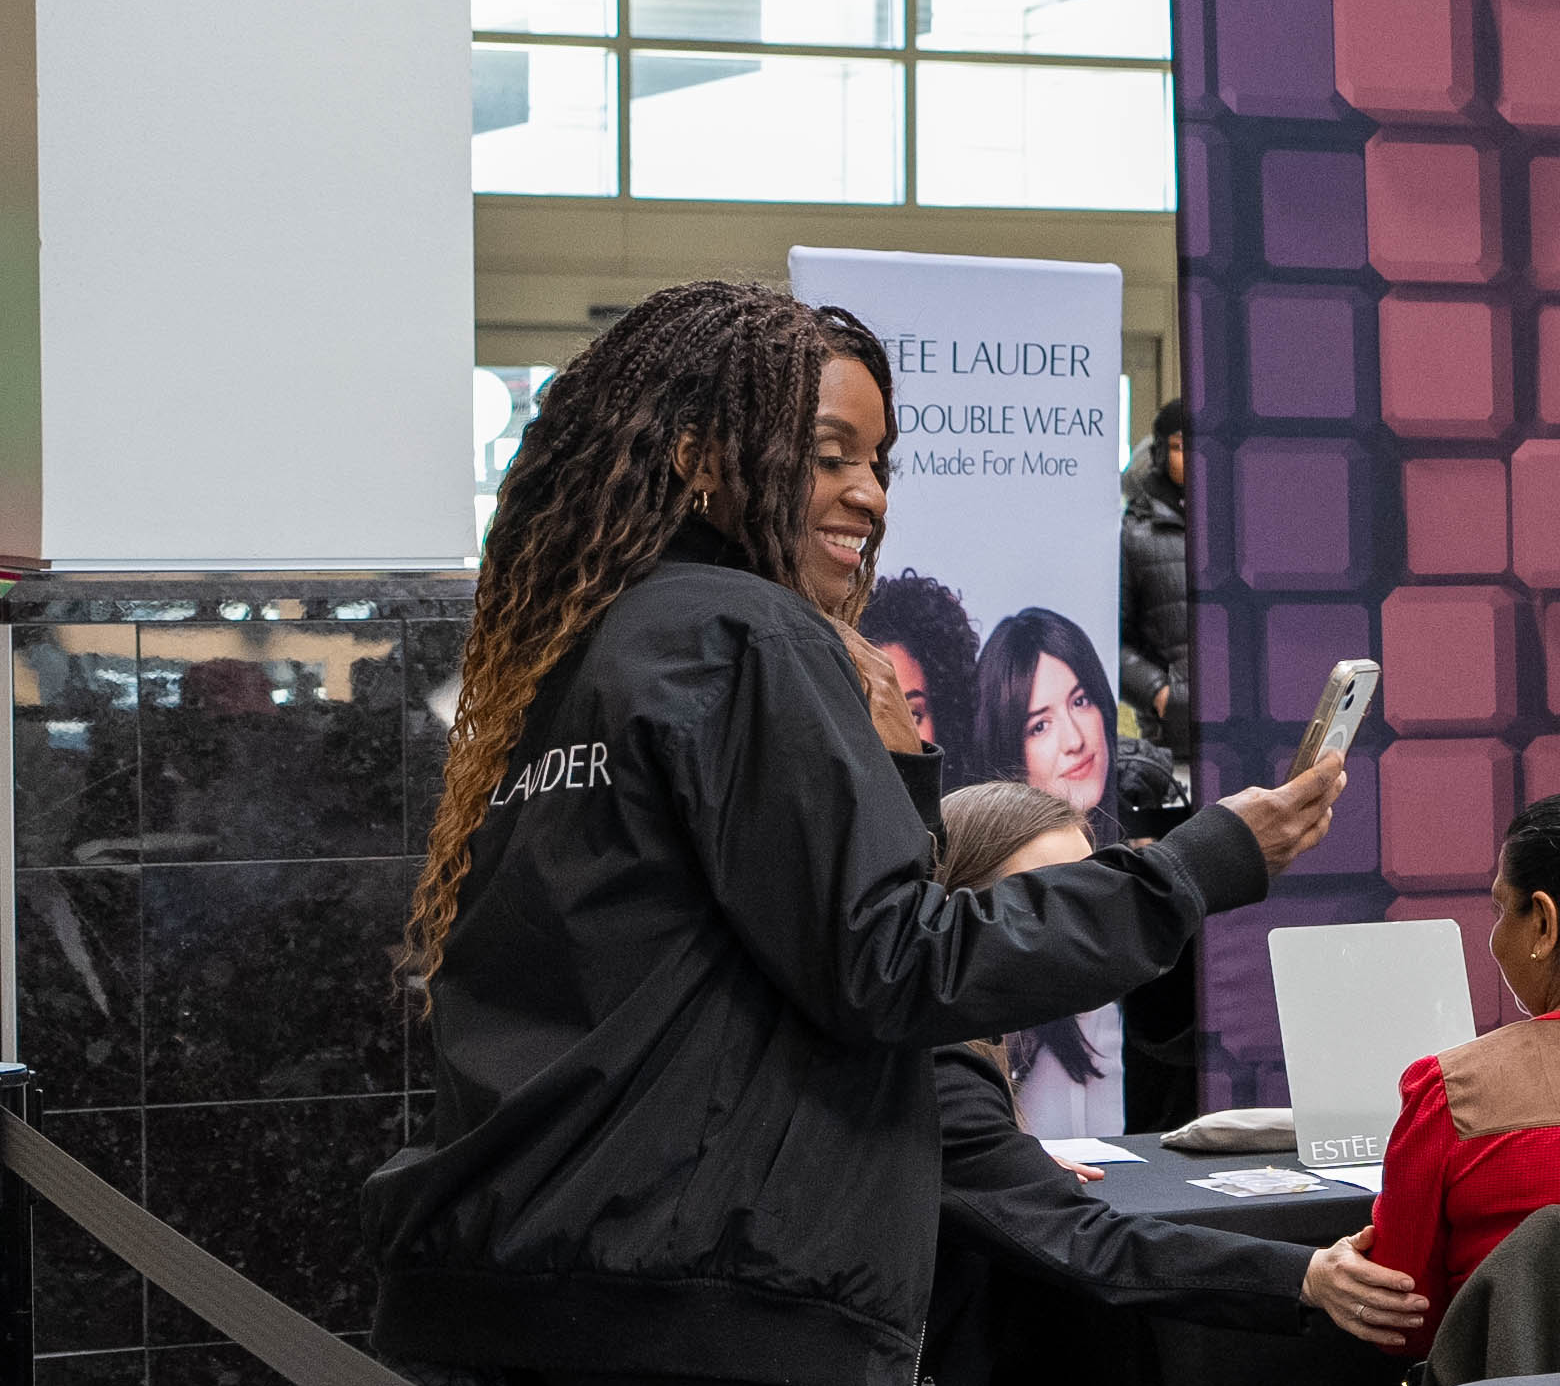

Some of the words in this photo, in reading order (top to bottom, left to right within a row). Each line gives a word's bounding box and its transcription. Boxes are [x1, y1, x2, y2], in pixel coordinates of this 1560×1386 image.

[951, 341, 1091, 378] LAUDER
[897, 403, 1016, 435] DOUBLE
[1022, 406, 1106, 437] WEAR
[911, 448, 976, 477] Made
[982, 450, 1016, 476] For
[1024, 451, 1079, 477] More
[490, 742, 612, 806] LAUDER
